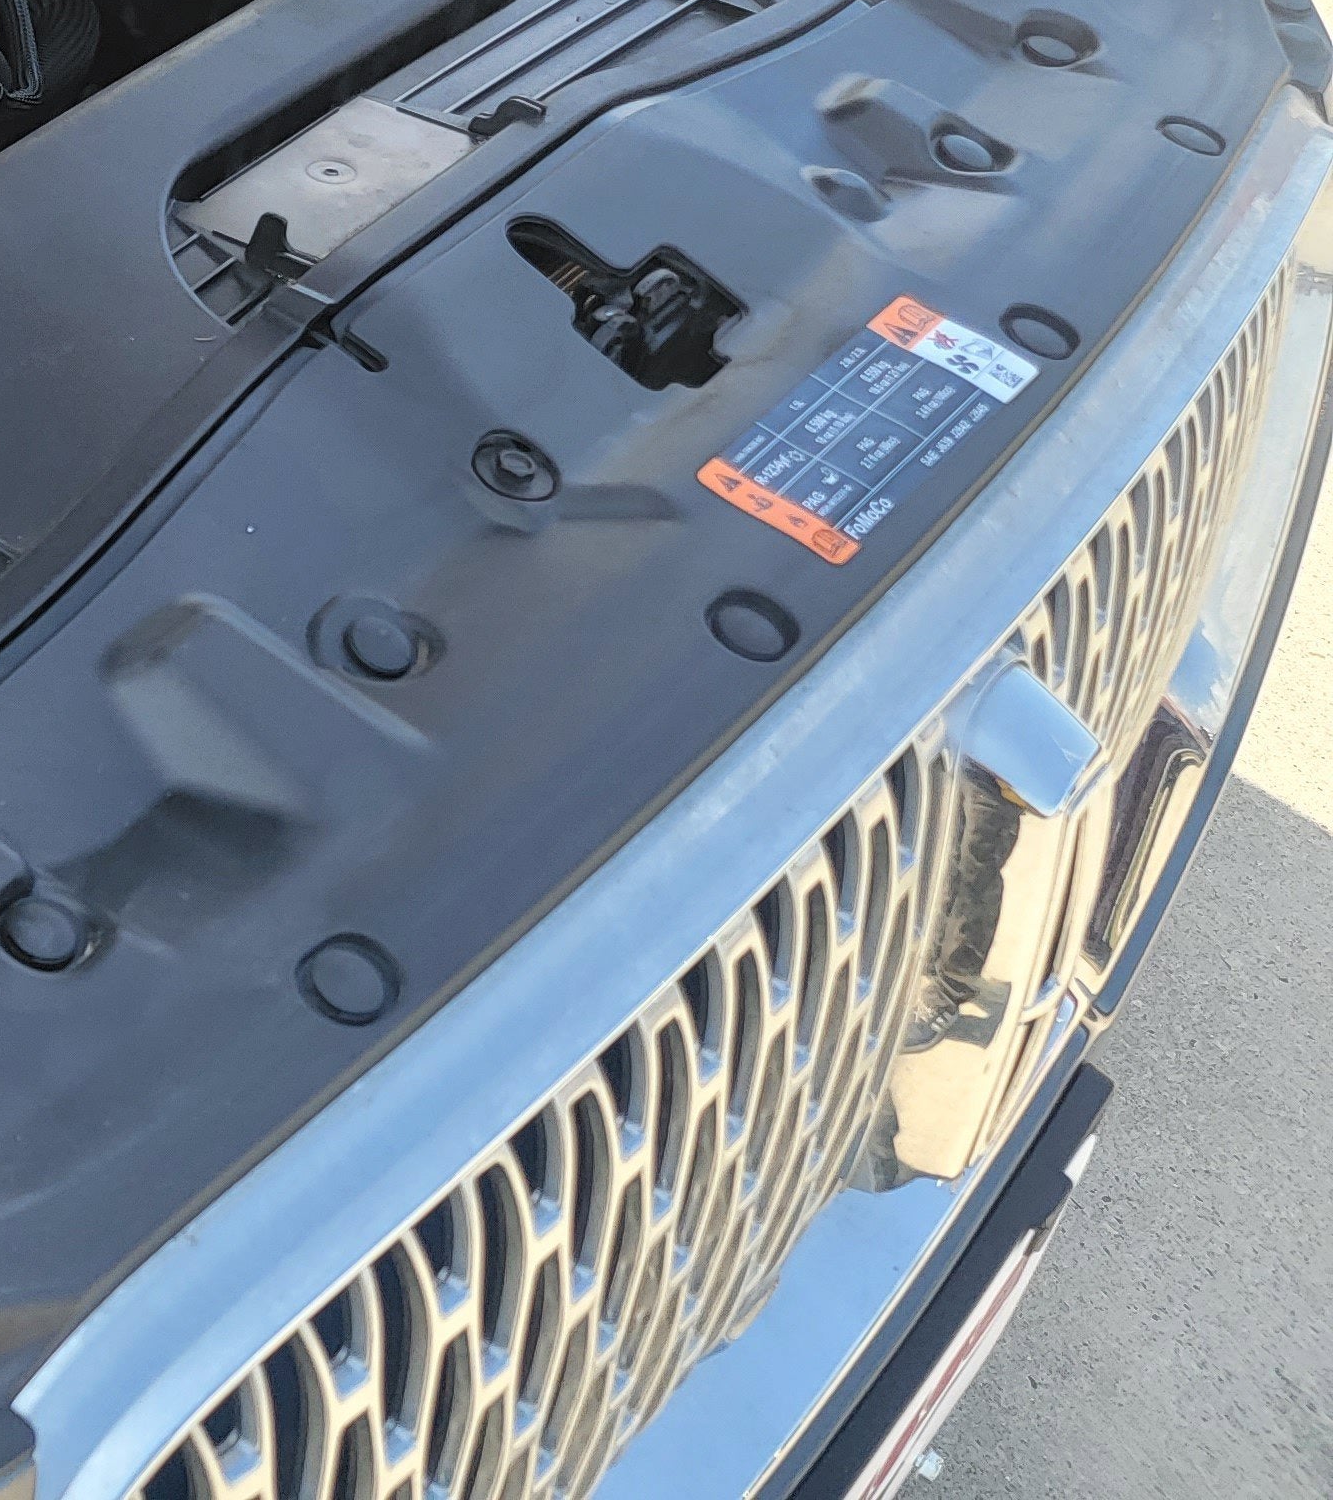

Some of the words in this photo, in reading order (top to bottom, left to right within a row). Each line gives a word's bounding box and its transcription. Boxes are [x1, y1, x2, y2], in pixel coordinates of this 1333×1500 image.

[751, 452, 795, 488] R-1234yf
[799, 488, 828, 511] PAG
[841, 493, 896, 541] FoMoCo
[918, 449, 941, 467] SAE
